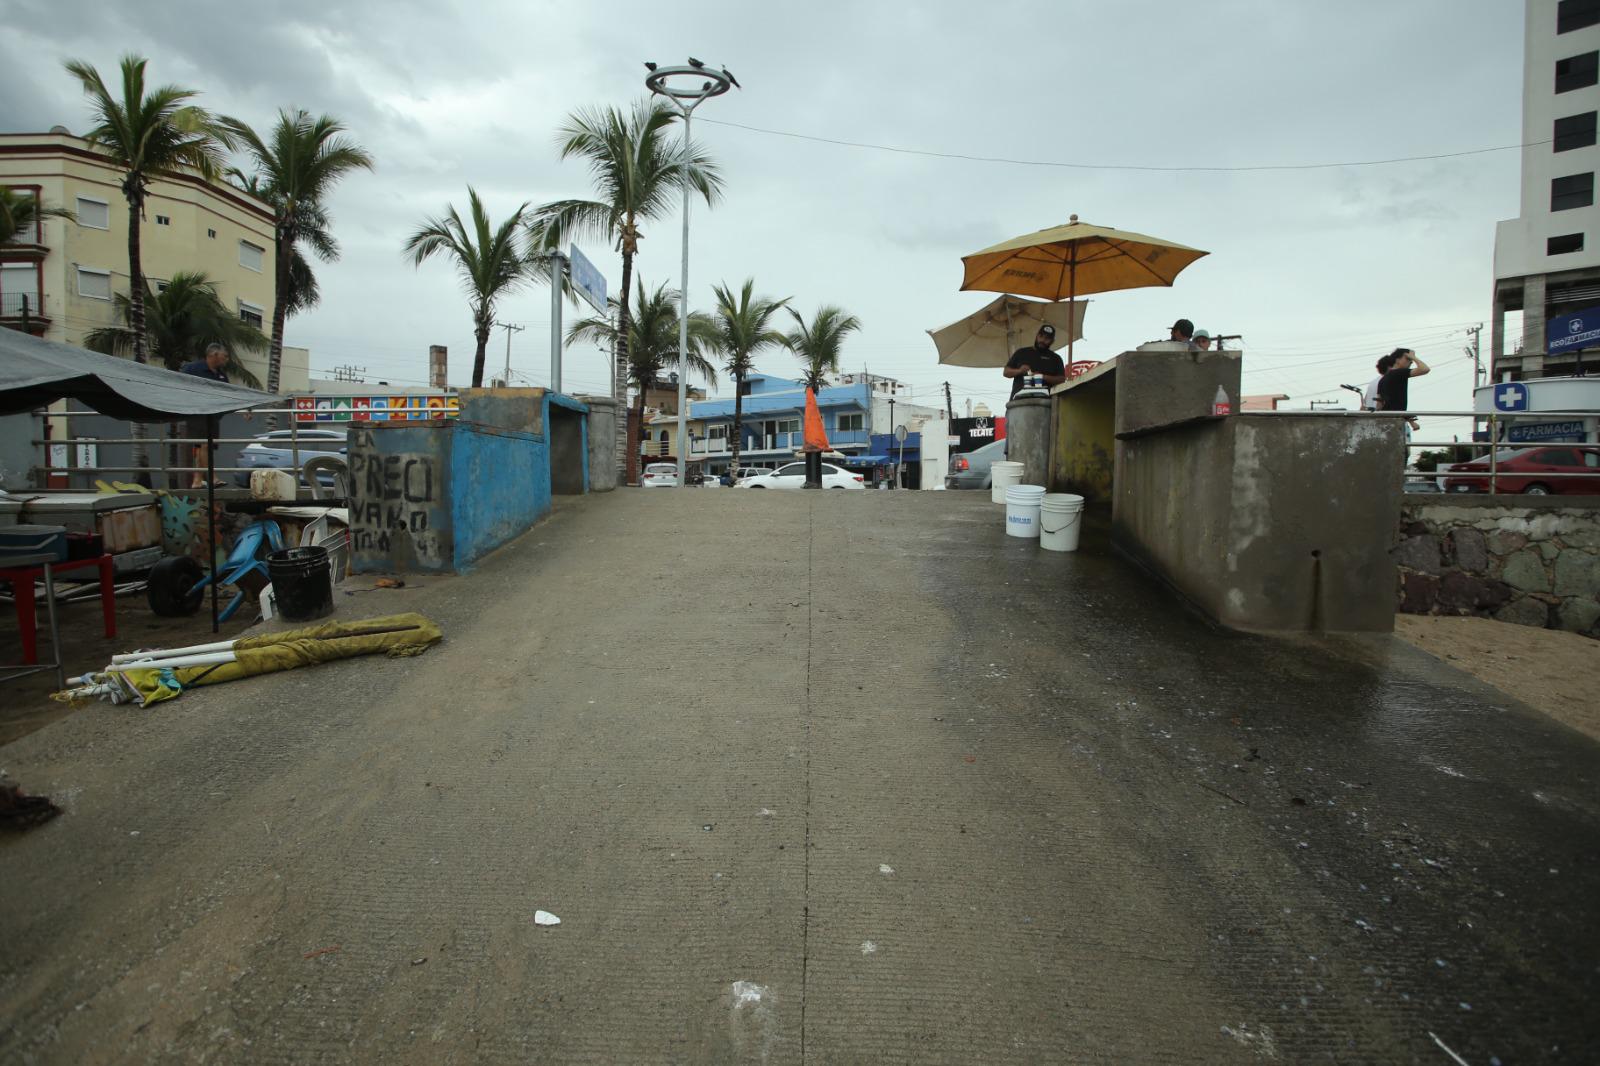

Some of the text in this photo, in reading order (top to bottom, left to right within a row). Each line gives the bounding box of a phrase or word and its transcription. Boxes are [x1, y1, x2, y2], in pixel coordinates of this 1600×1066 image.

[1565, 329, 1600, 345] FARMACI
[969, 427, 994, 437] TECATE
[1522, 423, 1583, 437] FARMACIA
